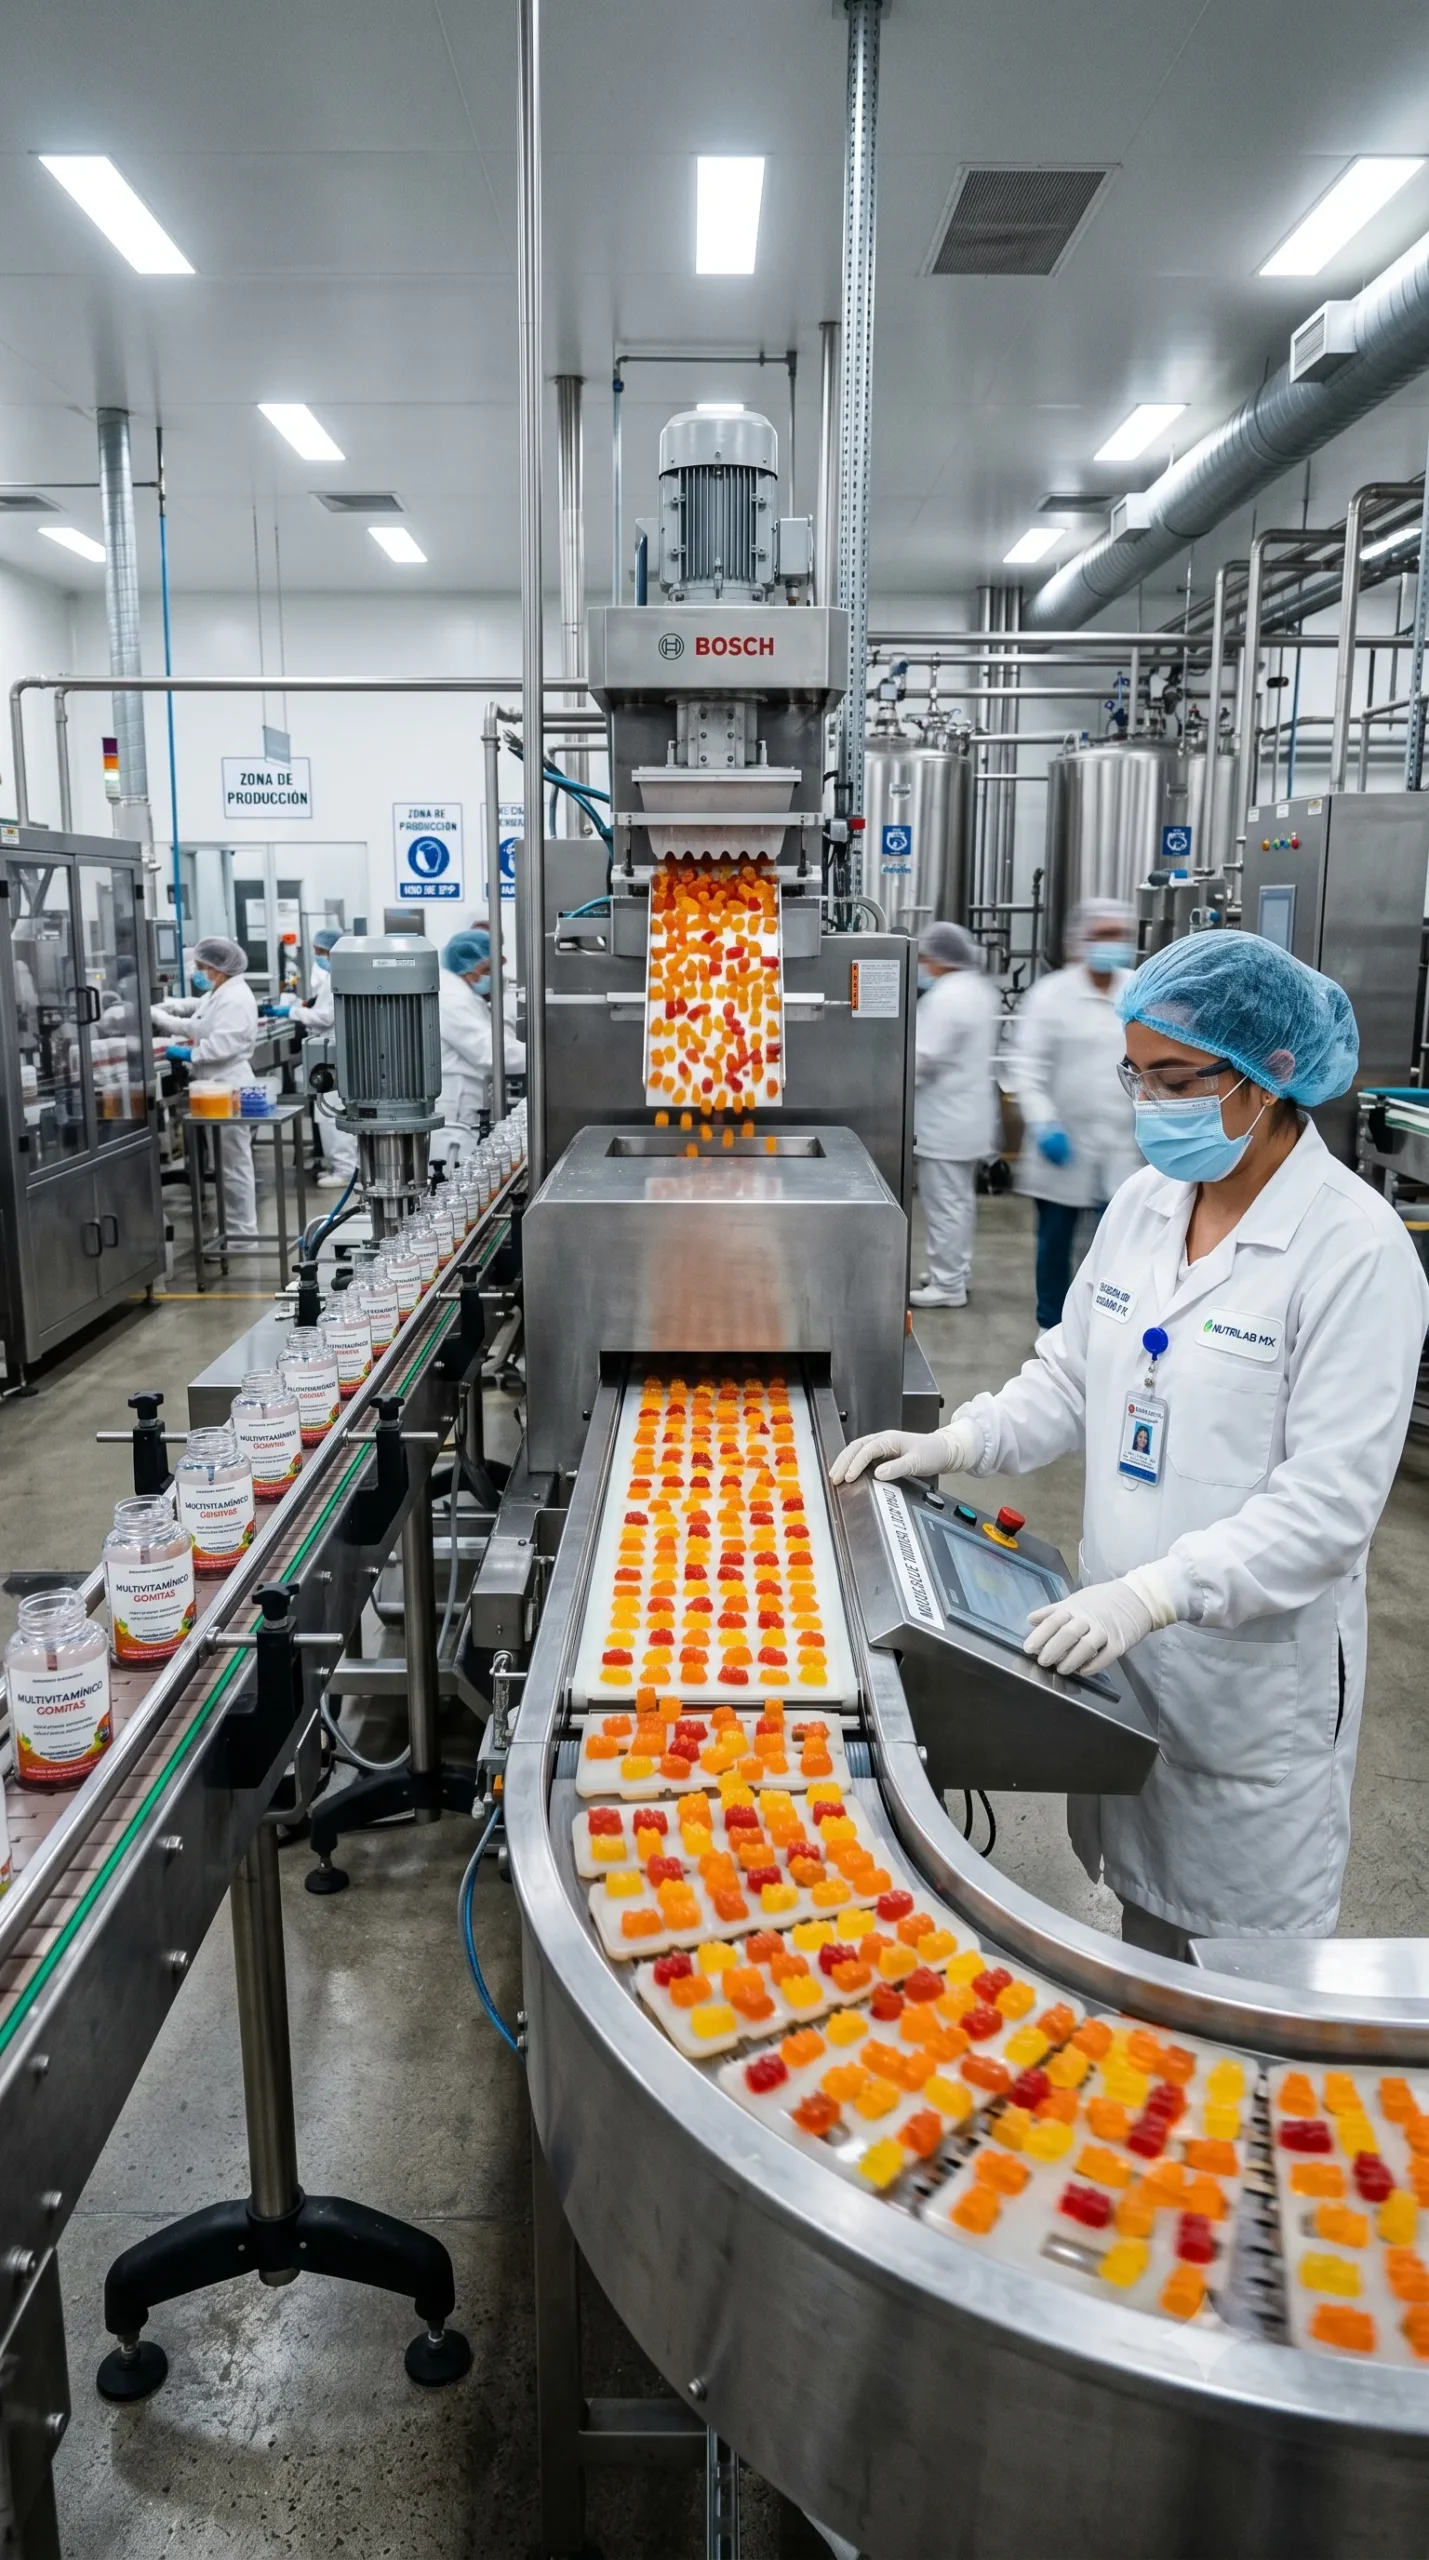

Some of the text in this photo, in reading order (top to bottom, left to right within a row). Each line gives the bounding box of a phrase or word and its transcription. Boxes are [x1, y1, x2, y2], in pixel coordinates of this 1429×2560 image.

[695, 636, 774, 656] BOSCH
[240, 773, 294, 786] ZONA DE
[227, 789, 308, 804] PRODUCCIÓN
[1258, 1335, 1277, 1348] MX
[116, 1573, 189, 1593] MULTIVITAMÍNICO
[133, 1589, 176, 1603] GOMITAS
[17, 1680, 103, 1704] MULTIVITAMÍNICO
